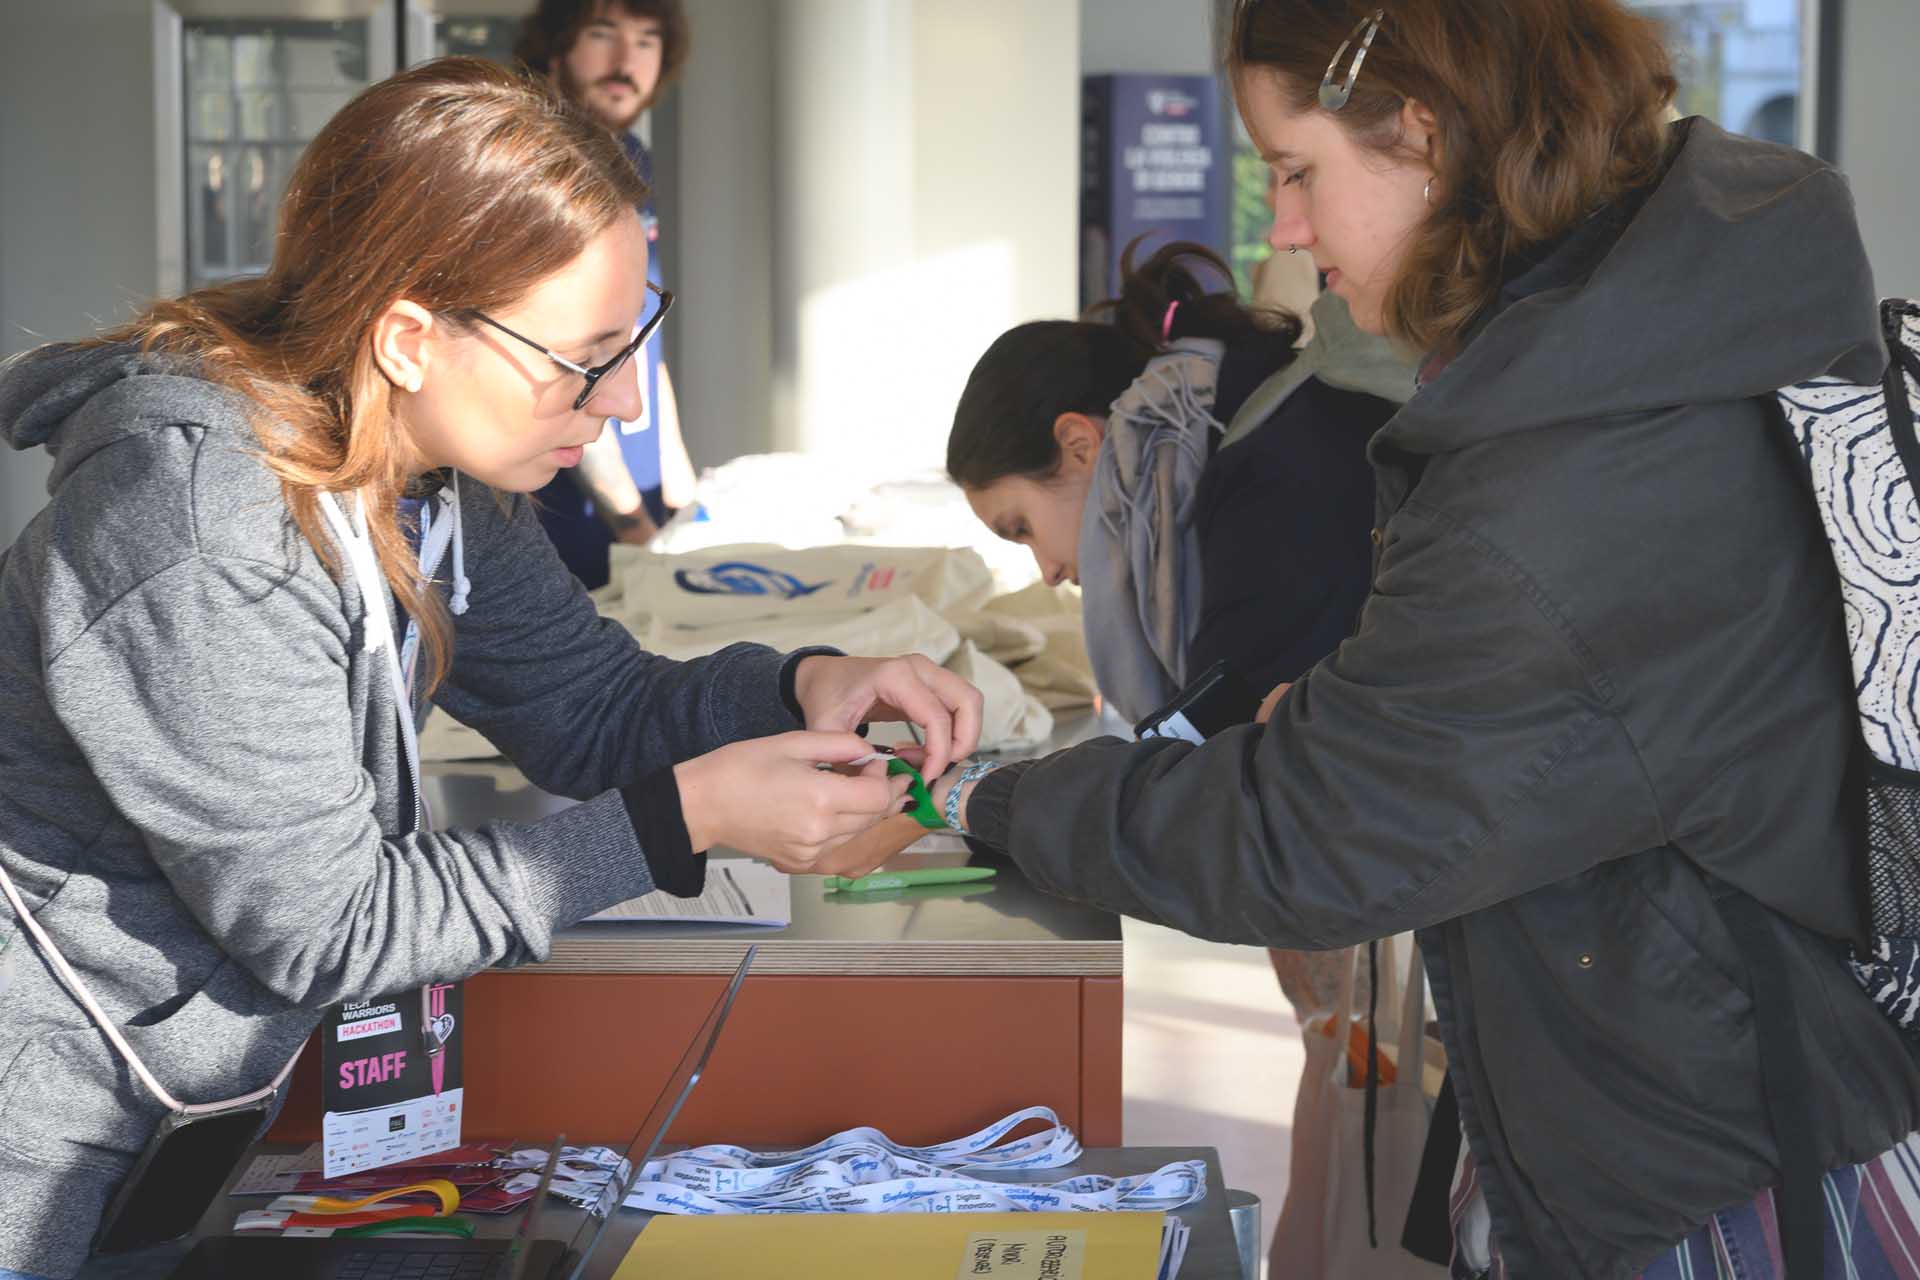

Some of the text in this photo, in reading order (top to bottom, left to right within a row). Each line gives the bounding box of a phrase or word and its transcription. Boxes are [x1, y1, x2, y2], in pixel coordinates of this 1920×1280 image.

[342, 1003, 396, 1020] WARRIORS
[342, 1019, 396, 1036] HACKATHON
[339, 1051, 407, 1089] STAFF
